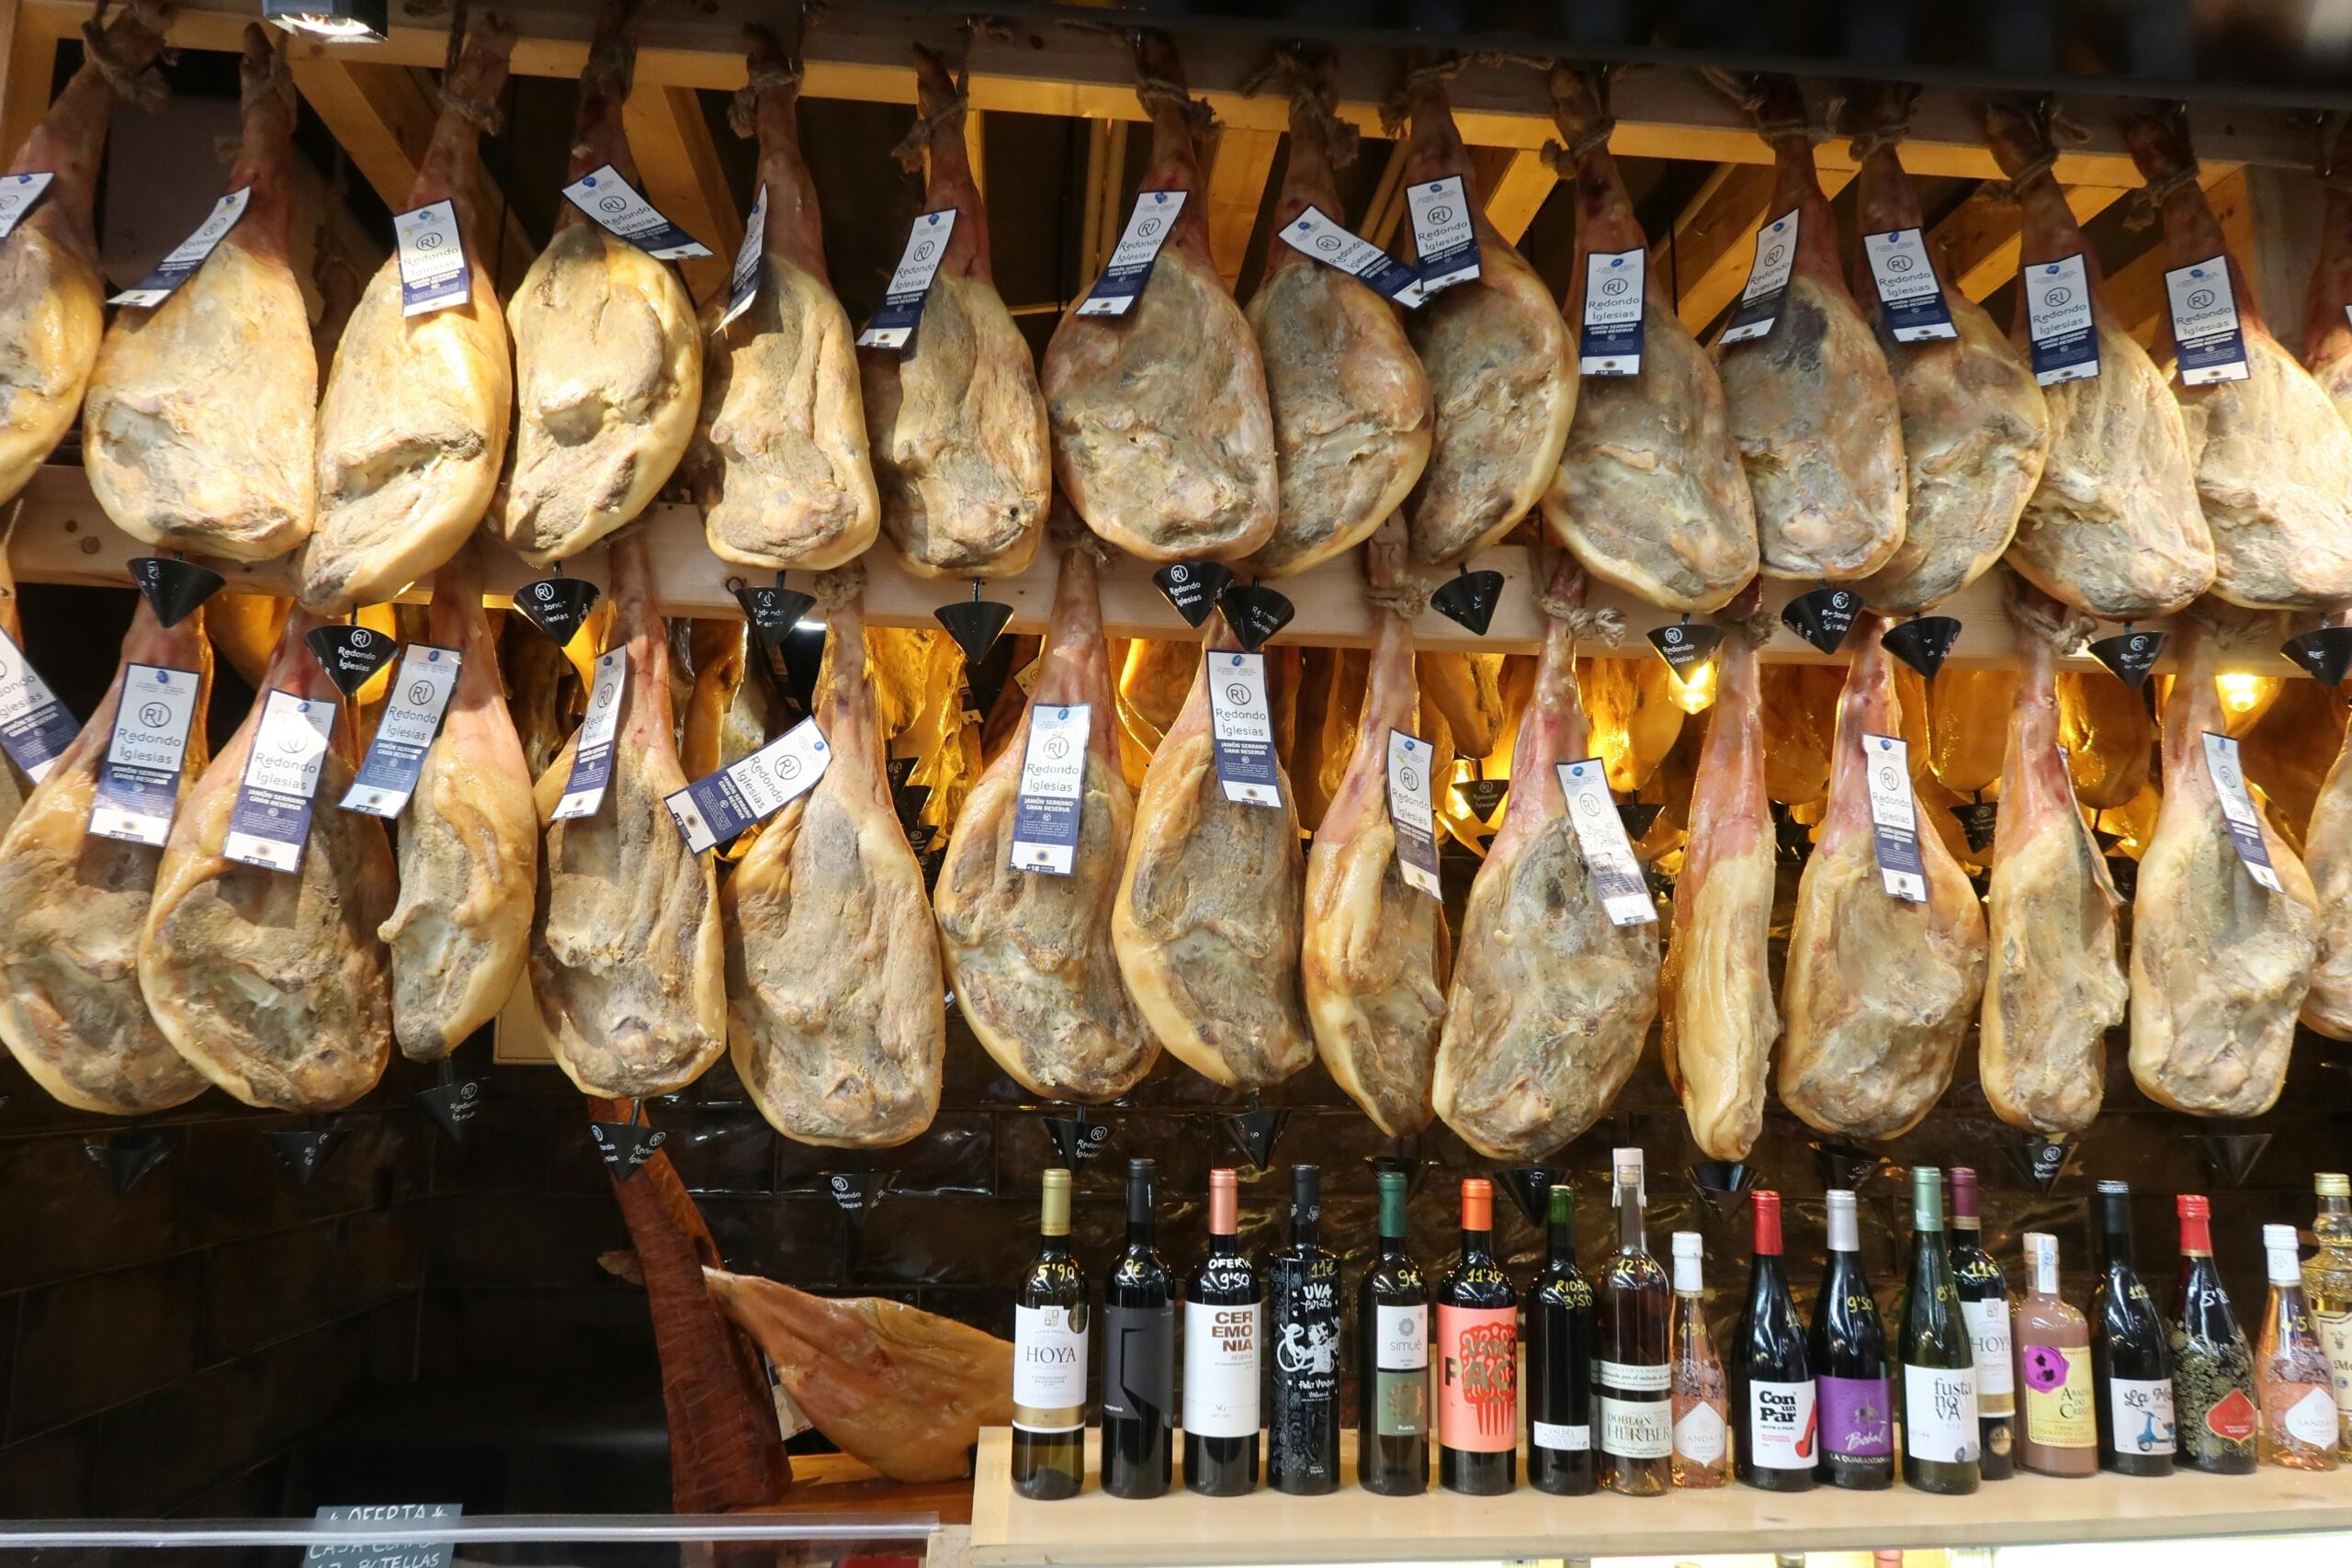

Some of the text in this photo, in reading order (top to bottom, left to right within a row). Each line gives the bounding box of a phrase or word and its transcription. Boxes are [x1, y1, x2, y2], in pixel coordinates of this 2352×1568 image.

[1418, 221, 1467, 241] Redondo
[1879, 272, 1931, 287] Redondo
[1589, 297, 1639, 310] Redondo
[2032, 303, 2086, 324] Redondo
[2176, 307, 2232, 325] Redondo
[338, 646, 376, 660] Redondo
[388, 705, 437, 726] Redondo
[1216, 707, 1266, 723] Redondo
[118, 728, 182, 748] Redondo
[255, 751, 317, 774] Redondo
[1027, 763, 1080, 777] Redondo
[750, 755, 785, 804] Redondo
[1393, 788, 1430, 810] Redondo
[1303, 1282, 1332, 1299] UVA
[1215, 1311, 1252, 1324] CER
[1212, 1325, 1253, 1337] EMO
[1223, 1340, 1253, 1352] NIA
[1025, 1347, 1076, 1363] HOYA
[1935, 1377, 1973, 1396] fusta
[1759, 1391, 1796, 1405] Con
[1760, 1407, 1797, 1423] Par
